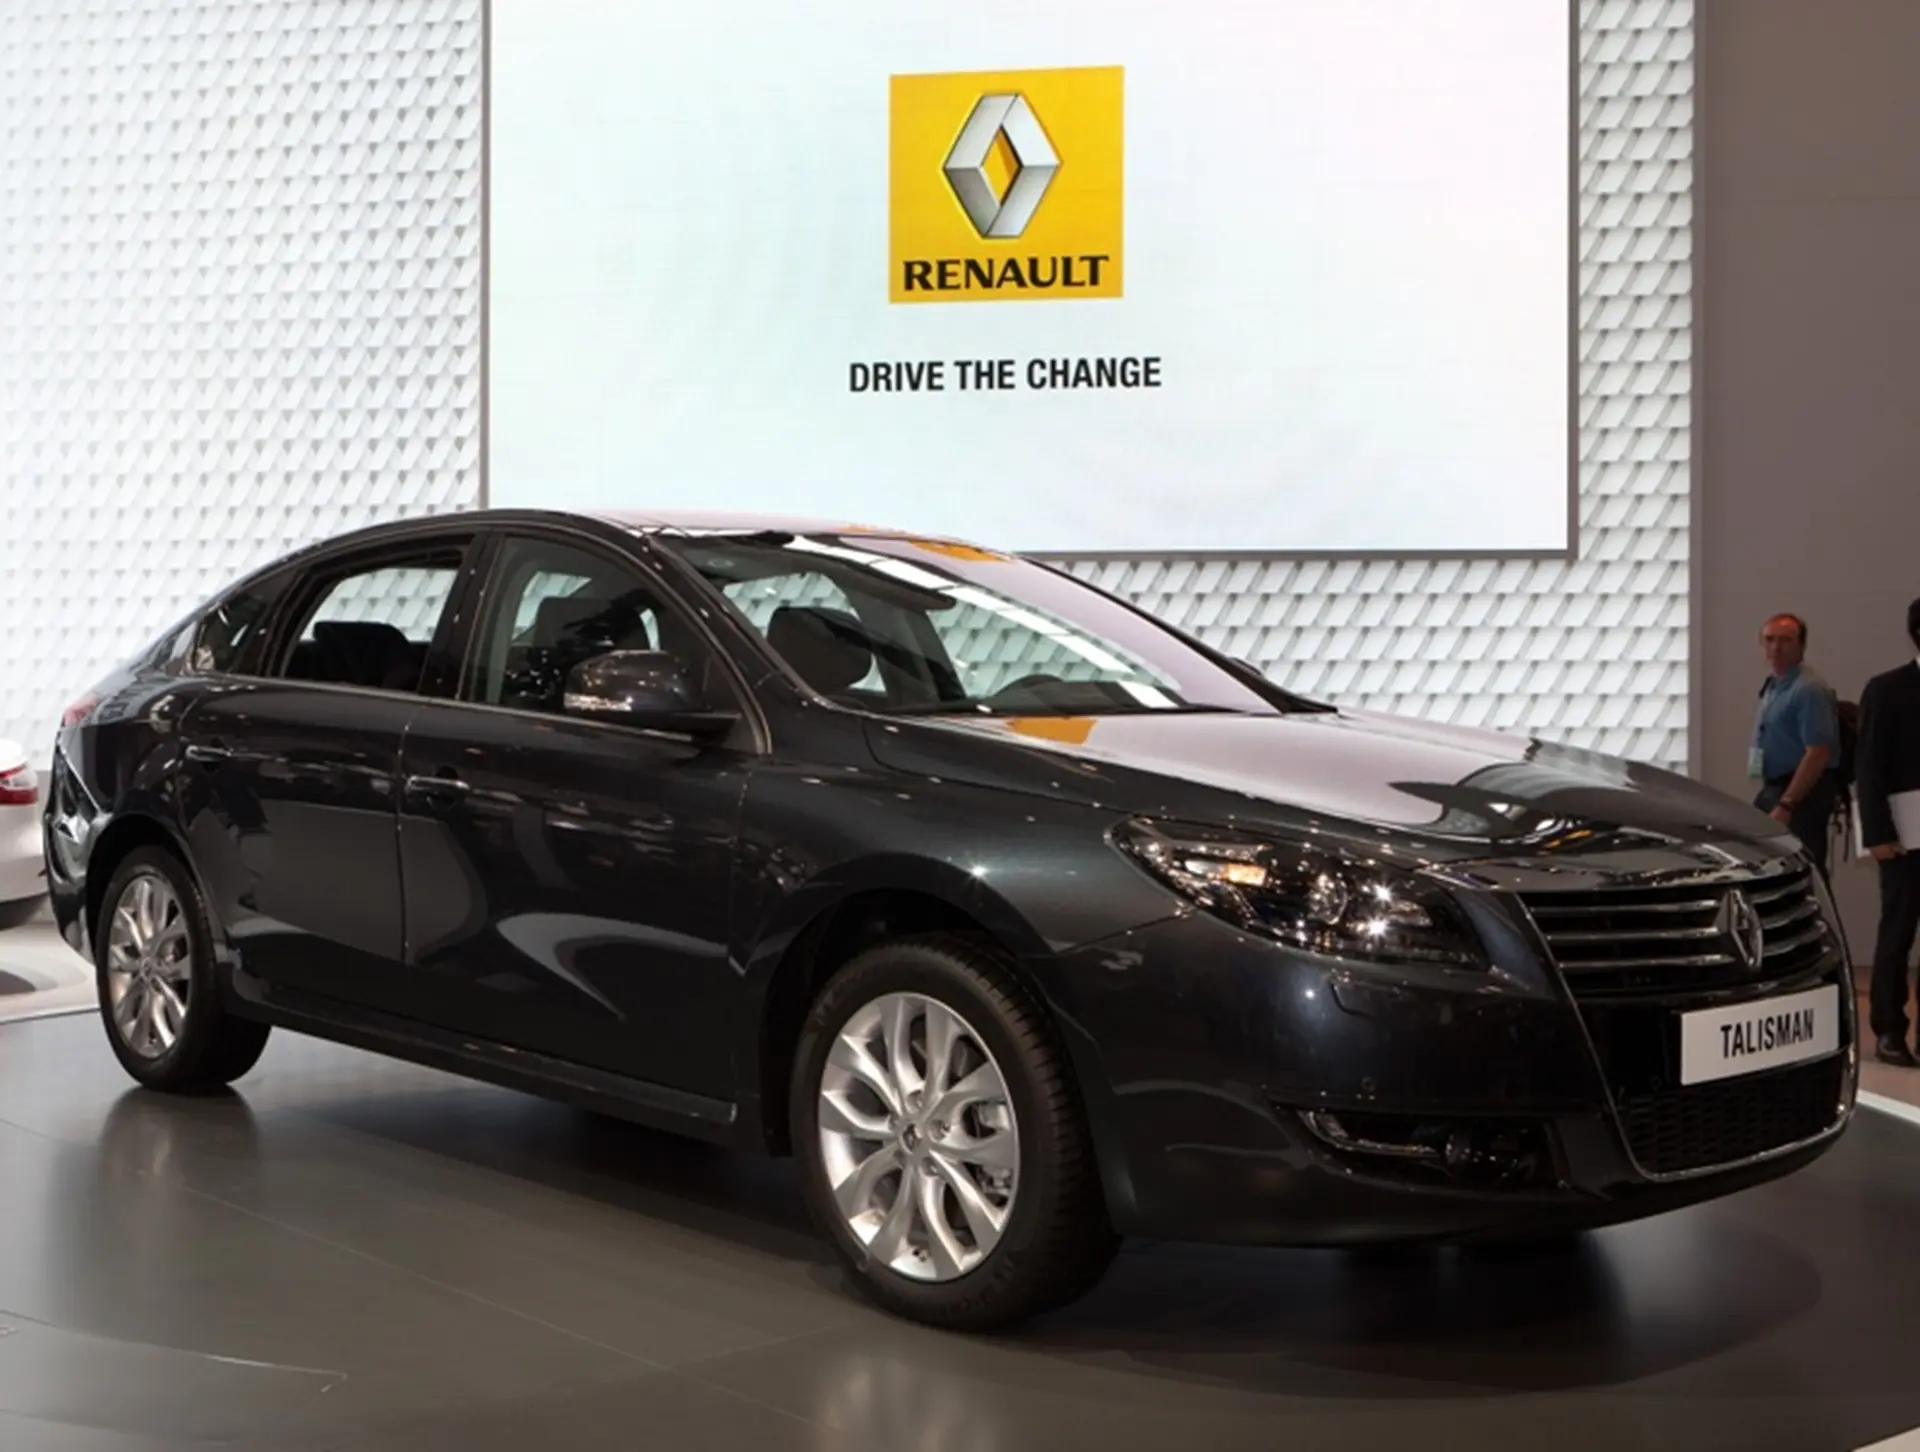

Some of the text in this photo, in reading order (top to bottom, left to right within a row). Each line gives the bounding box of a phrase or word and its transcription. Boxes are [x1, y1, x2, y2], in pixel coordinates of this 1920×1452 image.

[903, 255, 1109, 291] RENAULT
[849, 356, 1163, 393] DRIVE THE CHANGE
[1720, 1008, 1815, 1059] TALISMAN
